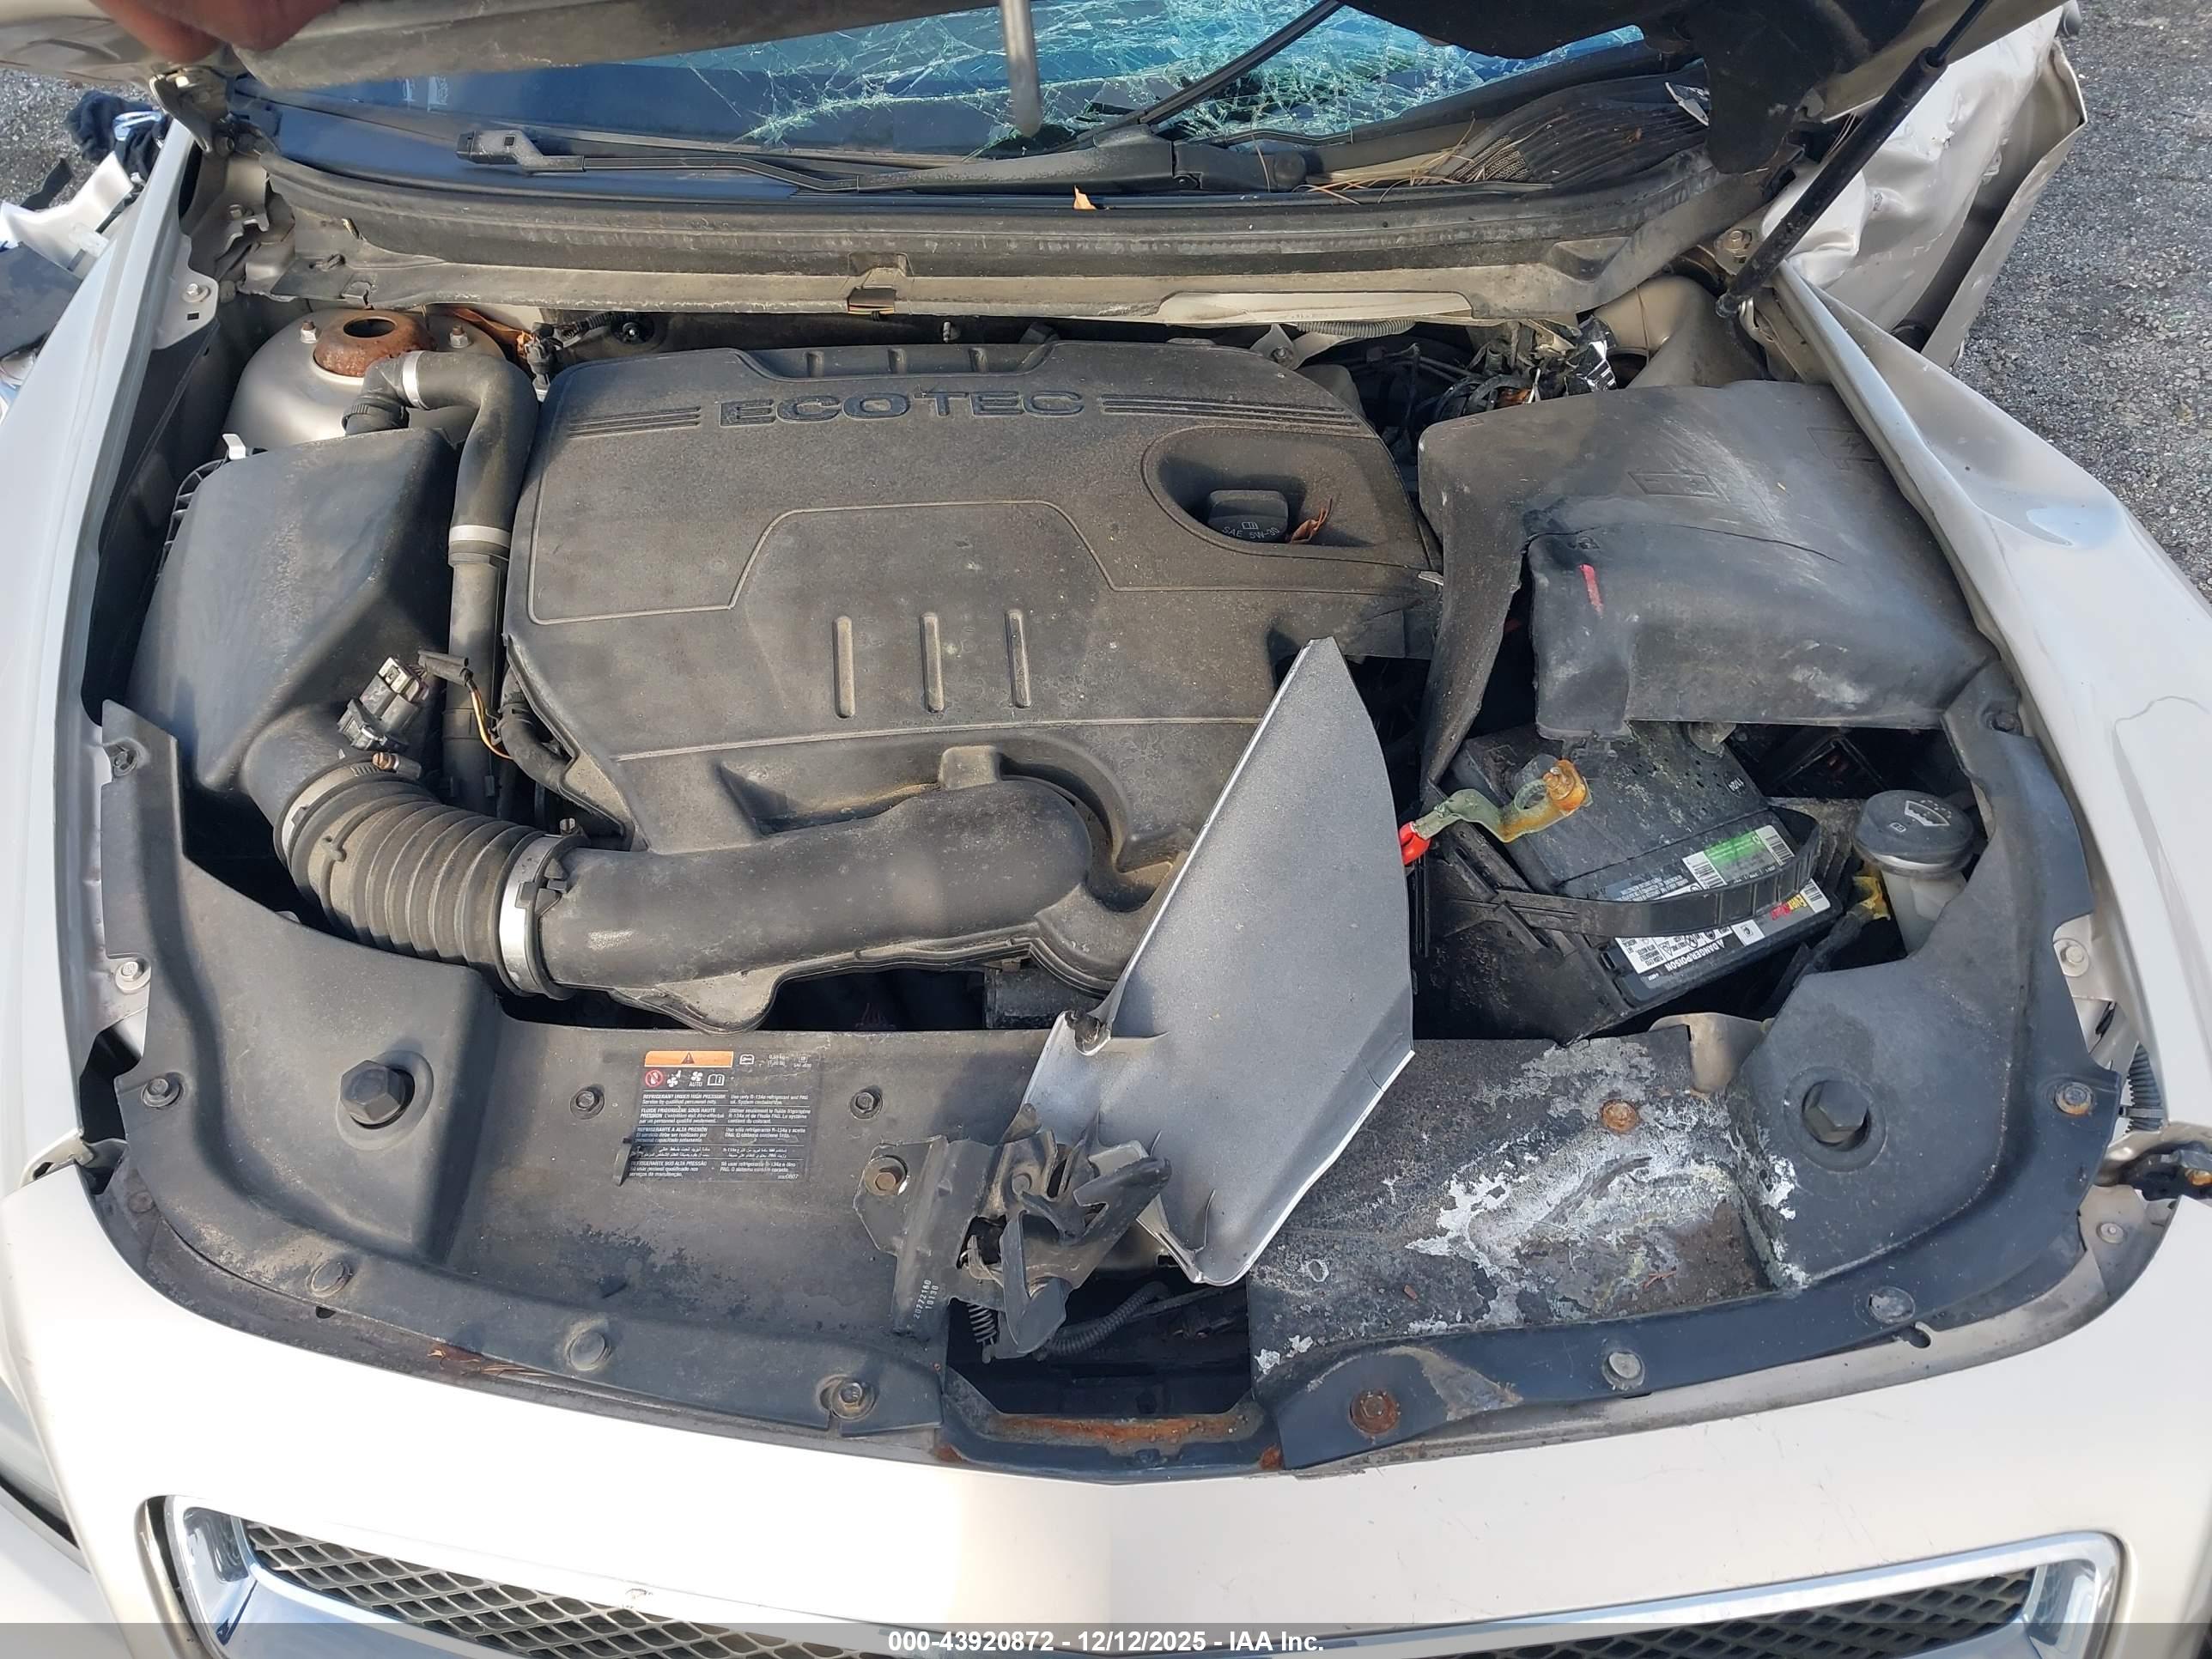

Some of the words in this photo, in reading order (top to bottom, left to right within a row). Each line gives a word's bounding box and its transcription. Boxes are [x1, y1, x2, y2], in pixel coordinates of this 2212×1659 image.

[719, 390, 1084, 428] ECOTEC
[1223, 526, 1243, 537] SAE
[1249, 527, 1279, 538] 5W-30
[1664, 941, 1721, 971] DANGER/POISON
[914, 1279, 932, 1319] 20772160
[925, 1285, 939, 1310] 10130
